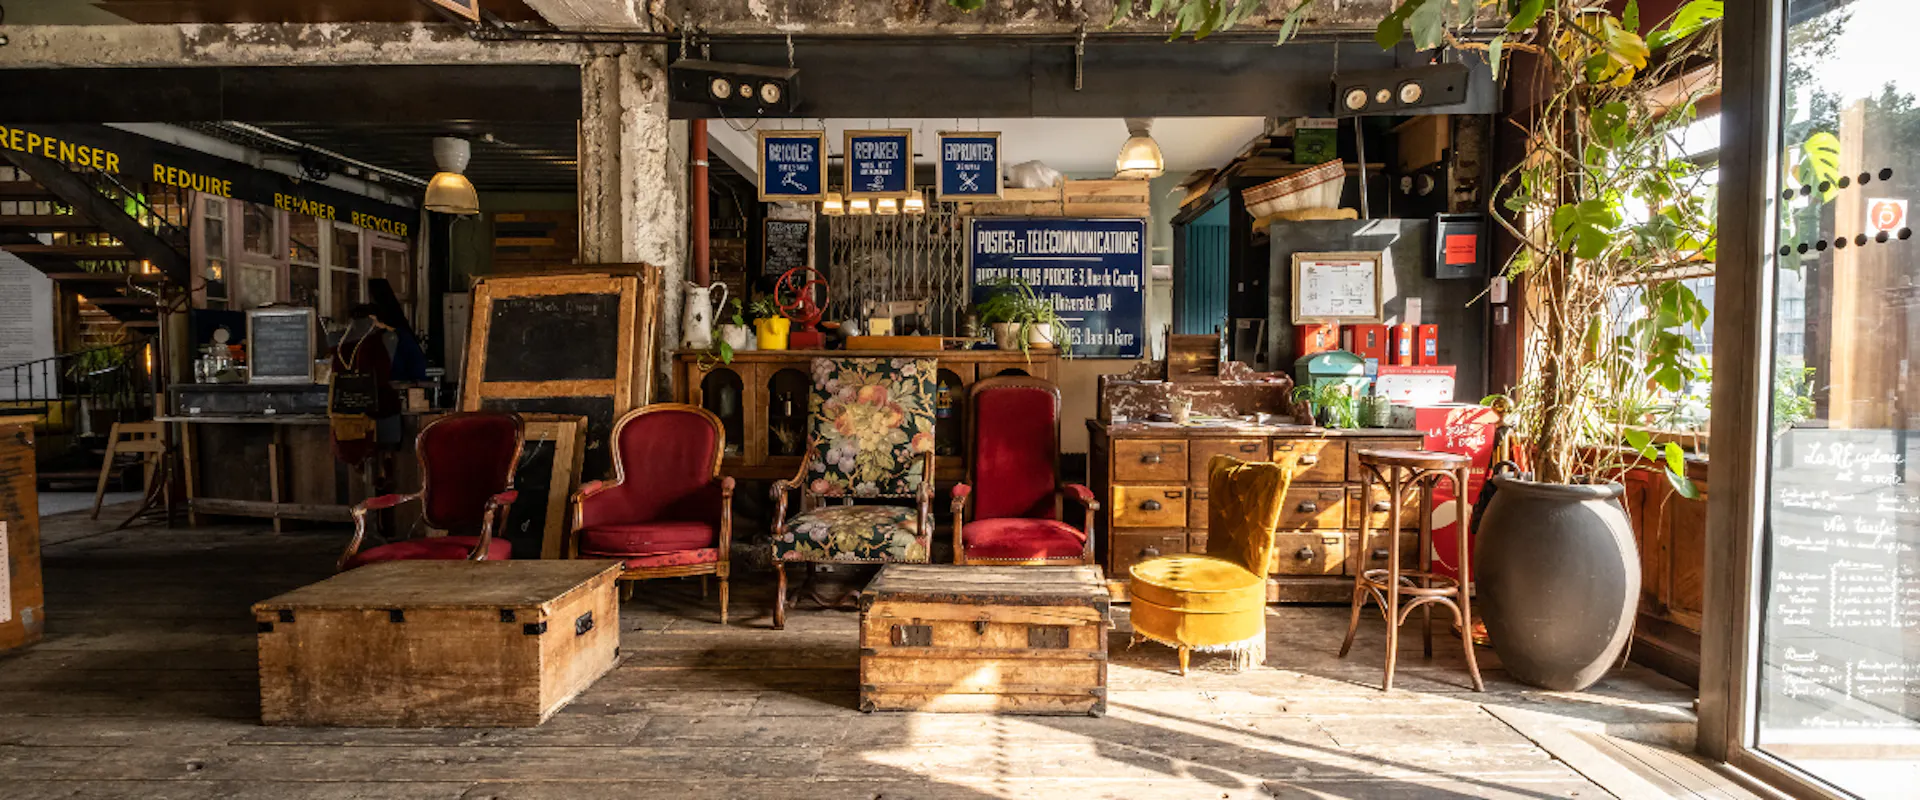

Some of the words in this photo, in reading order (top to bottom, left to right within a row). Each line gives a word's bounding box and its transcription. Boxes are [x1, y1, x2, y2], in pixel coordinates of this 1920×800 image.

[0, 125, 120, 168] REPENSER
[768, 143, 813, 162] BRICOLER
[945, 143, 993, 161] EMPRUNTER
[153, 163, 232, 198] REDUIRE
[351, 210, 407, 237] RECYCLER
[977, 230, 1015, 253] POSTES
[1097, 294, 1112, 311] 104
[1114, 327, 1135, 346] Gare
[1804, 441, 1825, 464] La
[1824, 514, 1847, 532] Nos
